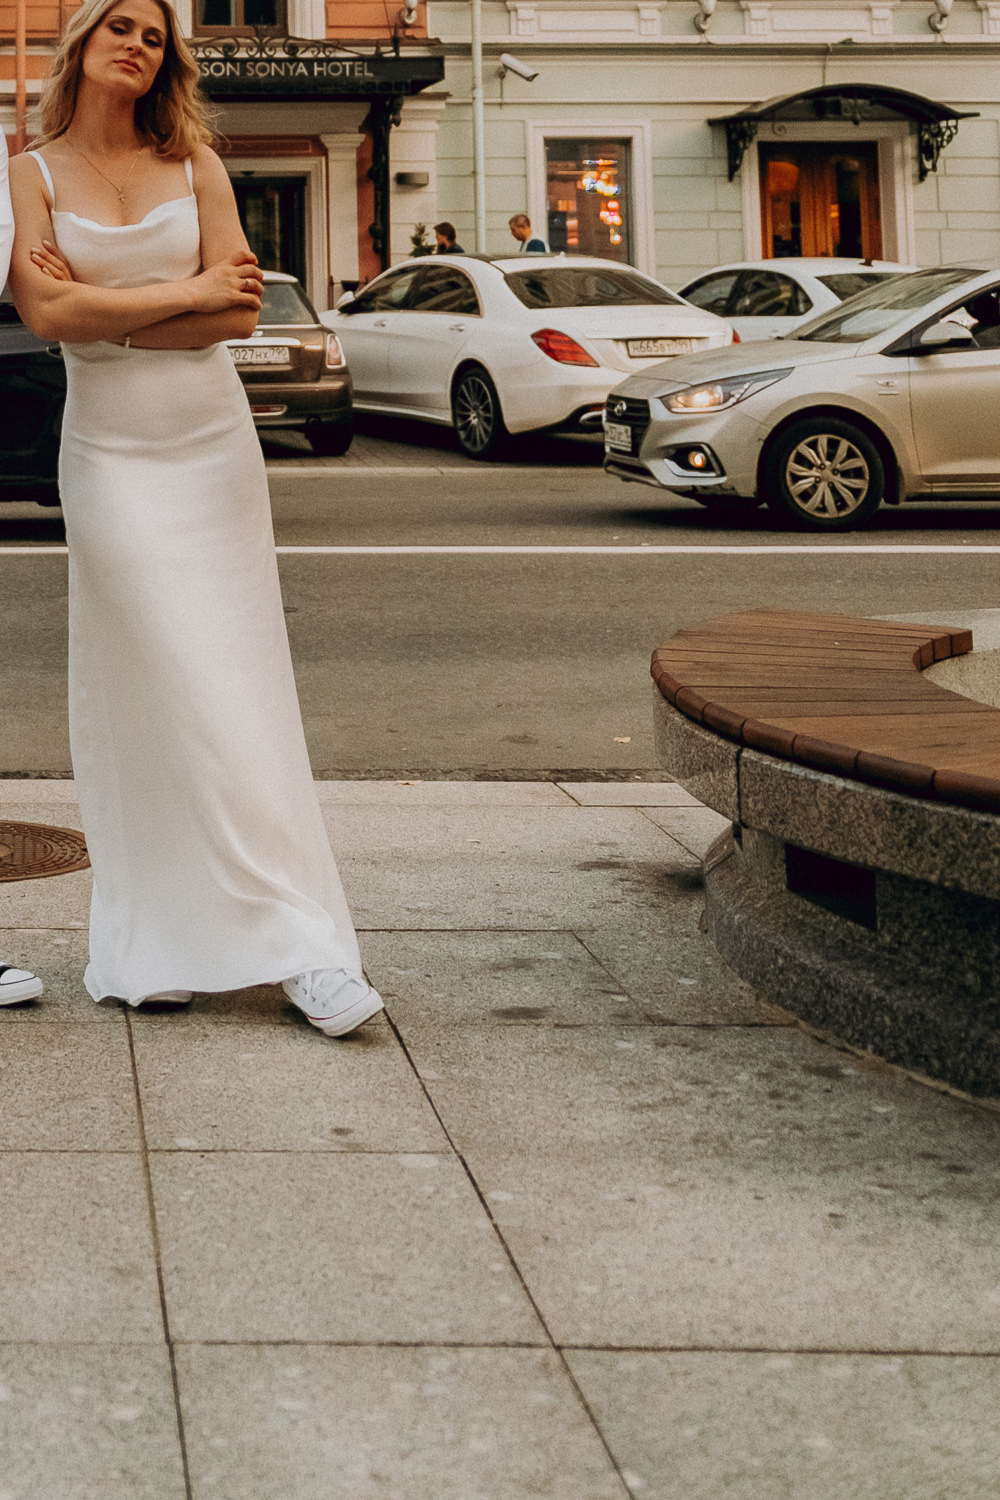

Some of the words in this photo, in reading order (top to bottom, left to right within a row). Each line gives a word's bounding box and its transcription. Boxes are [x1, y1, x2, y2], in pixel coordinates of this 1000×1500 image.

[198, 61, 240, 78] SON
[246, 61, 308, 78] SONYA
[313, 61, 374, 78] HOTEL
